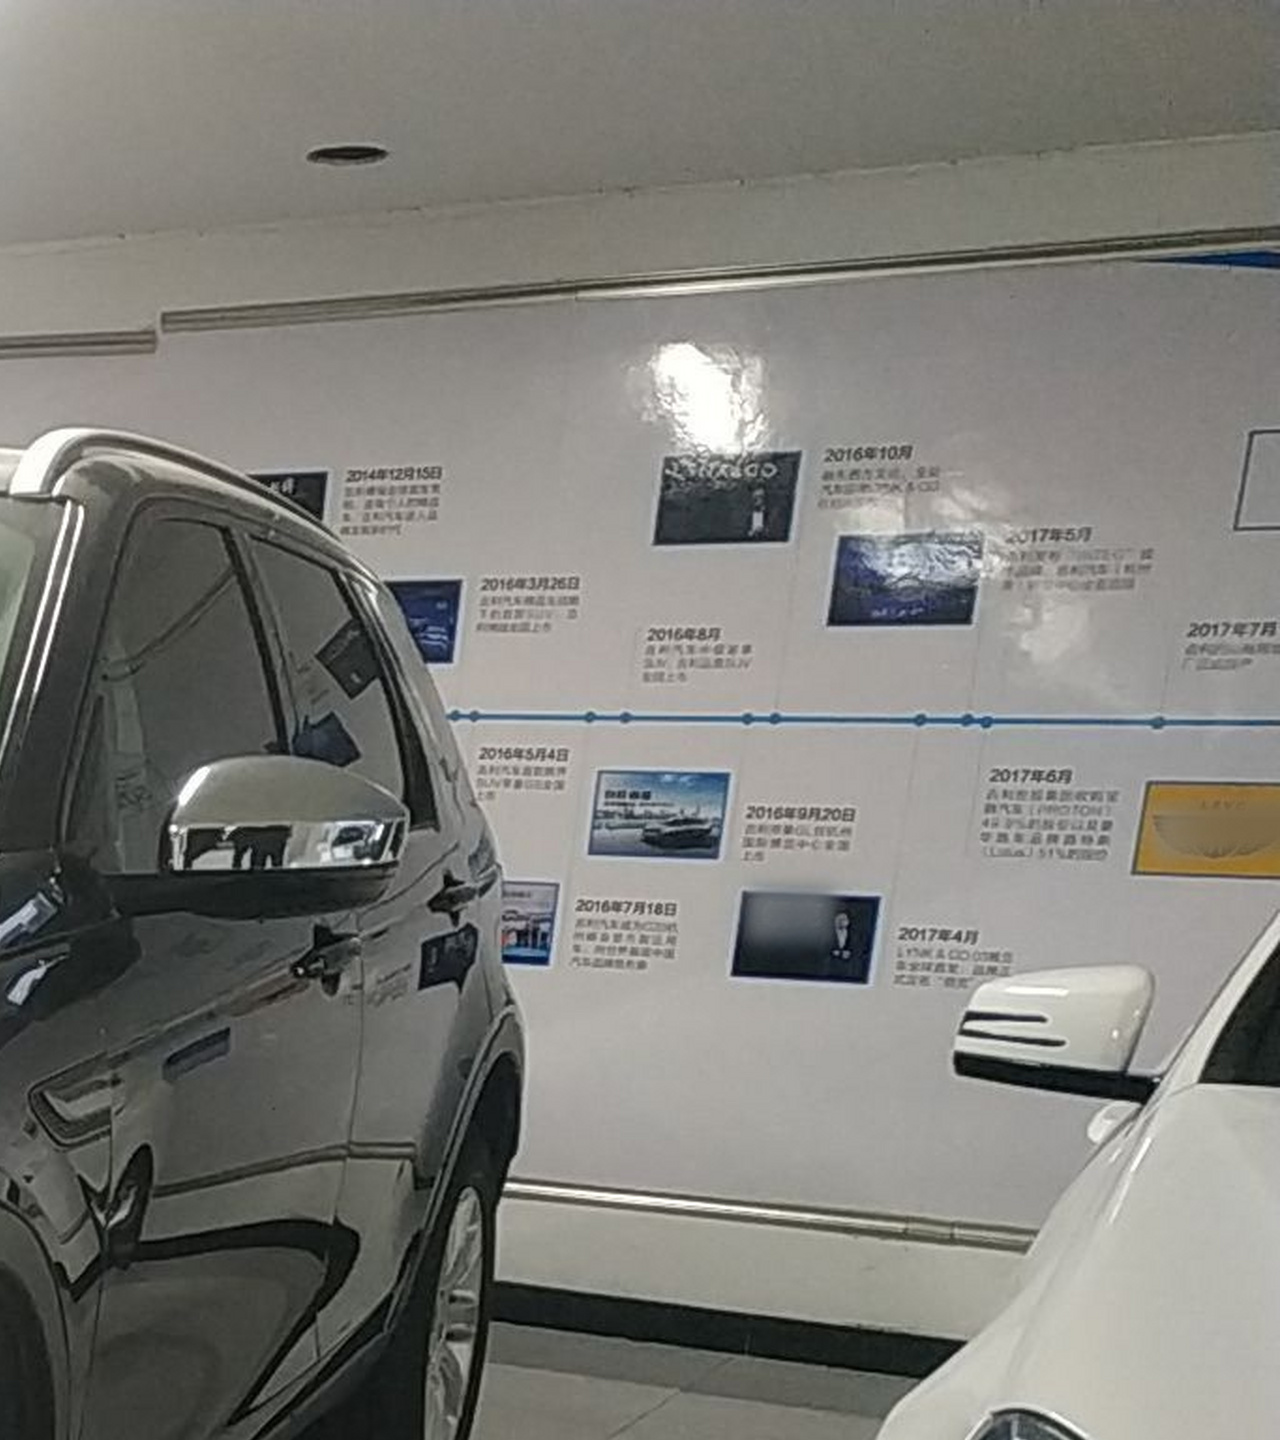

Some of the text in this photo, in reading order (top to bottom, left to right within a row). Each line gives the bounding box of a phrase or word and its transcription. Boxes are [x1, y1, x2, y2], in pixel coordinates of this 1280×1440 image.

[823, 445, 914, 463] 2016年10月
[345, 466, 442, 483] 2014年12月15日
[480, 576, 581, 591] 2016年3月26日
[646, 627, 722, 642] 2016年8月
[1186, 621, 1278, 638] 2017年7月
[479, 746, 570, 762] 2016年5月4日
[989, 768, 1073, 785] 2017年6月
[745, 805, 857, 822] 2016年9月20日
[574, 898, 678, 916] 2016年7月18日
[897, 927, 980, 946] 2017年4月
